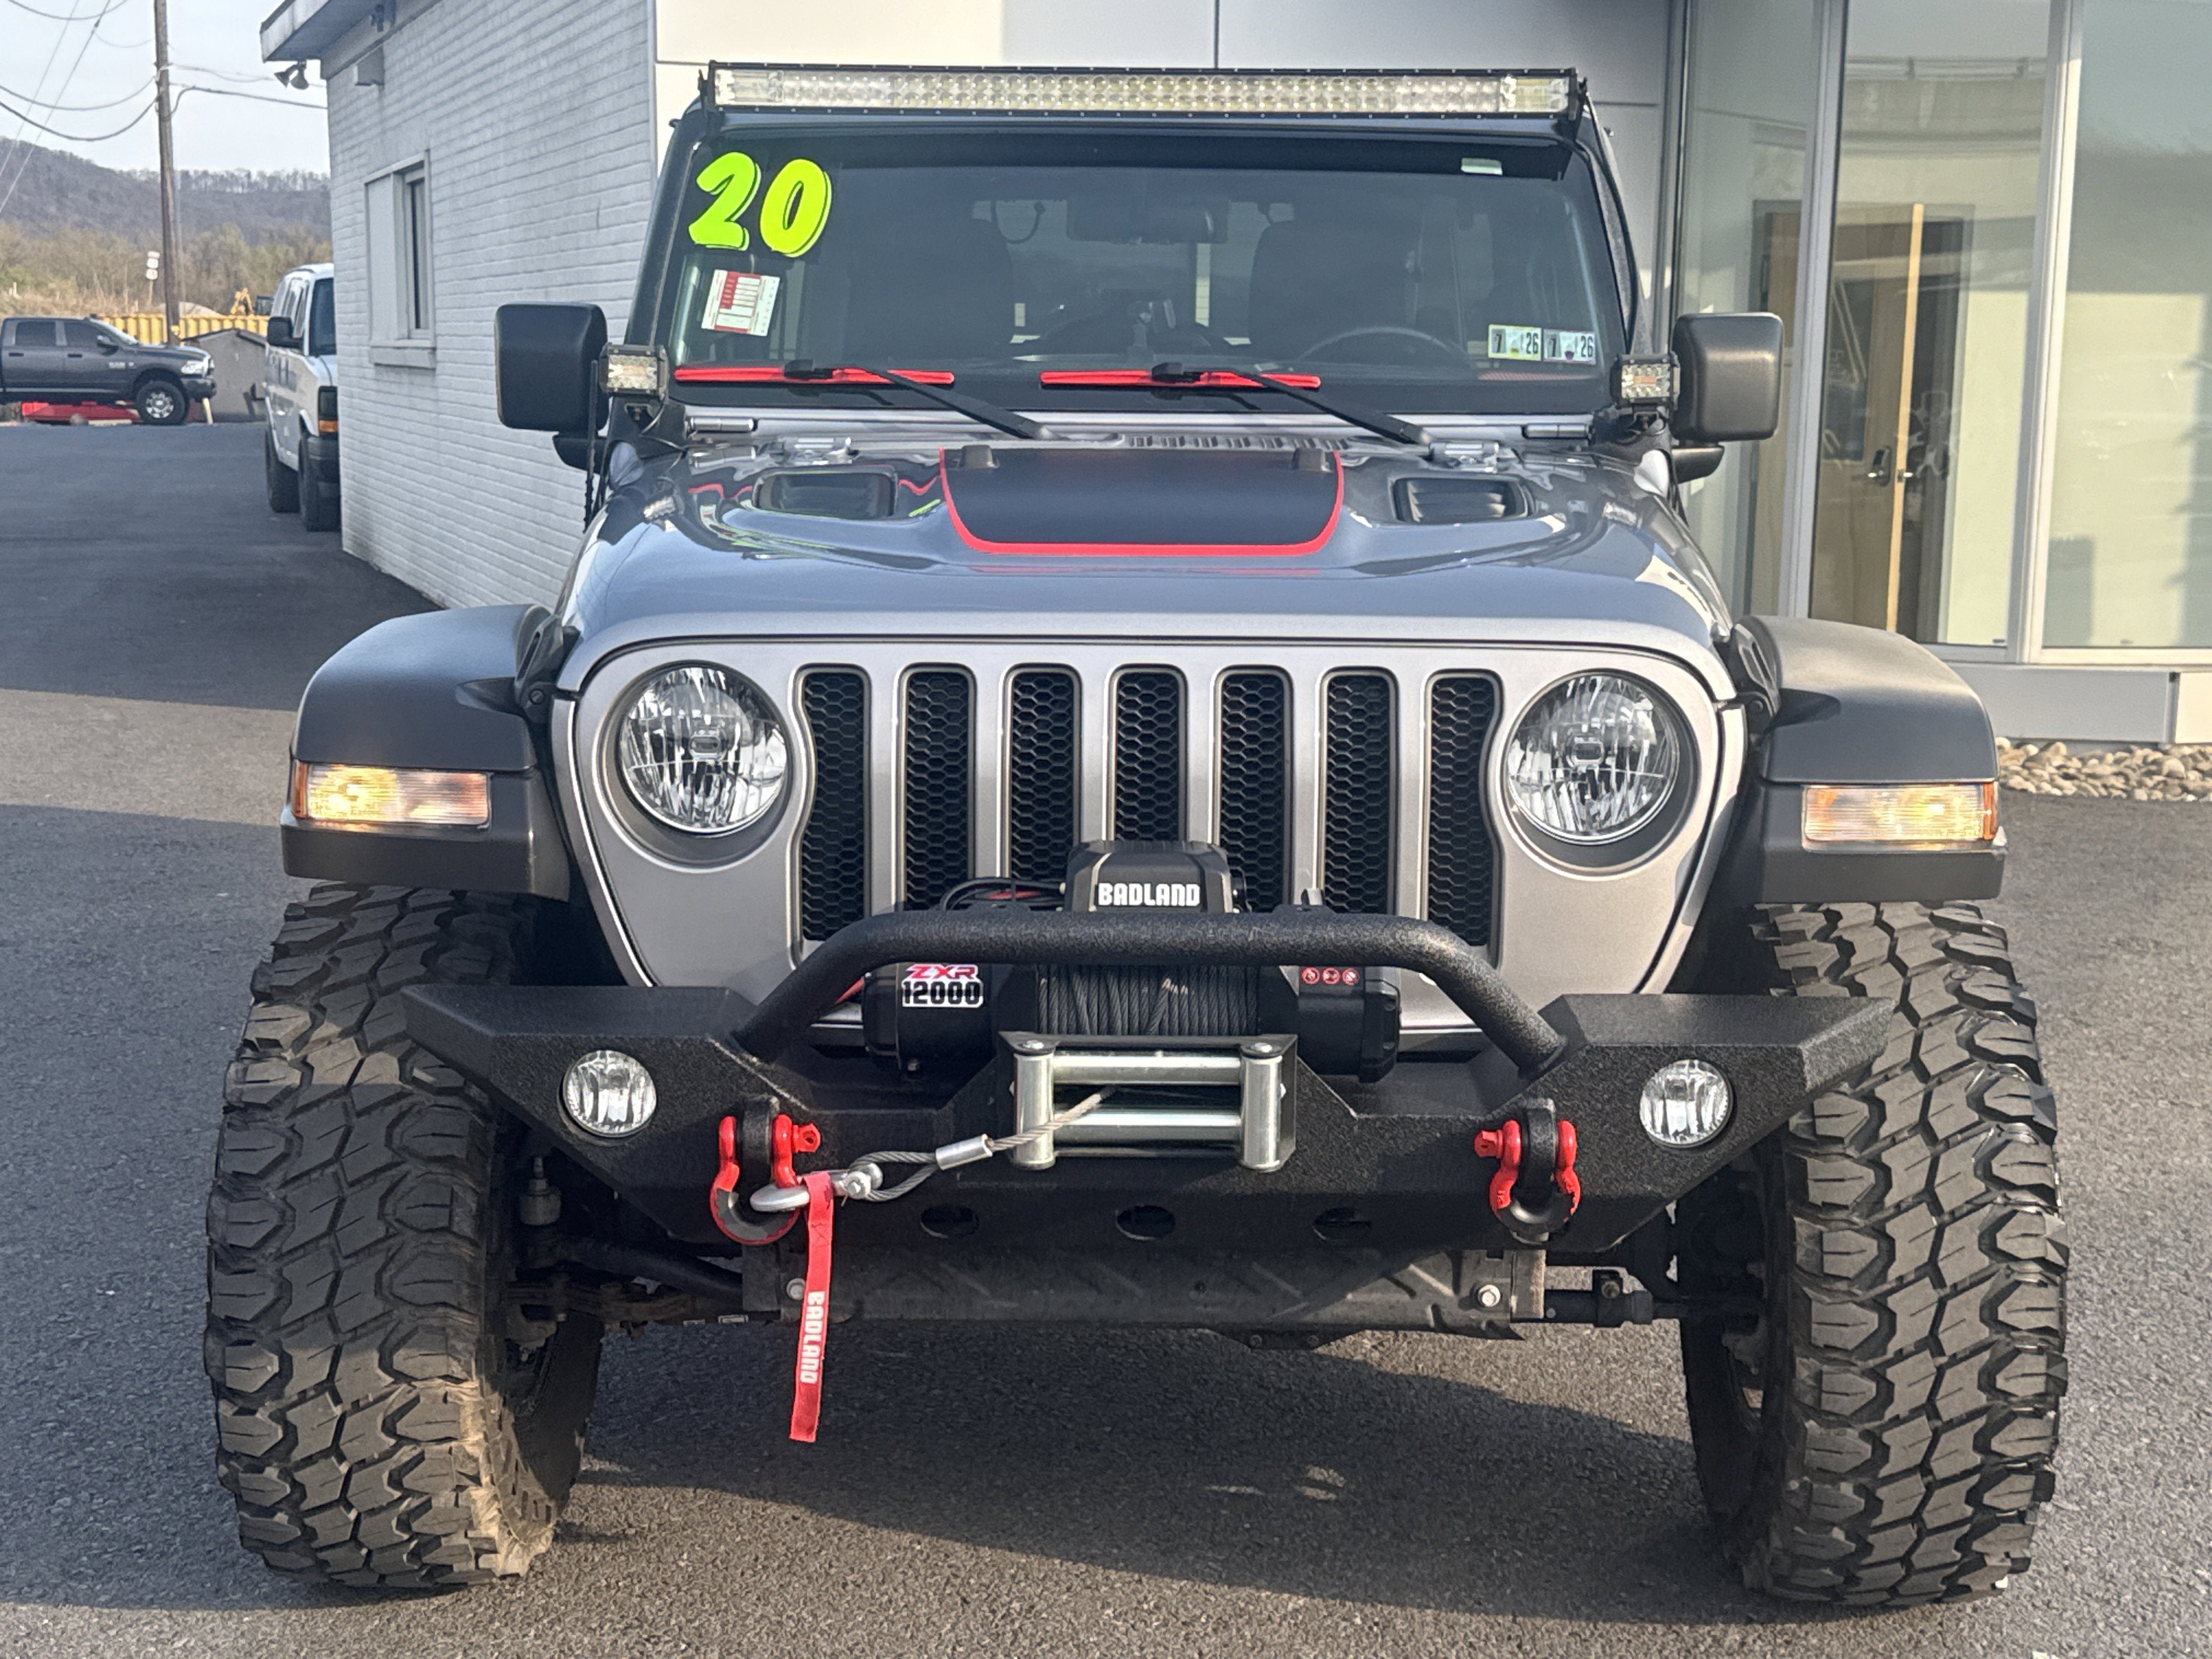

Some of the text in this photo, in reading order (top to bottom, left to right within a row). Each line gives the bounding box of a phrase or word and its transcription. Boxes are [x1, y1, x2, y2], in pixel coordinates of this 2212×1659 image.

[688, 151, 832, 258] 20
[1526, 332, 1539, 354] 26
[1581, 335, 1593, 357] 26
[1098, 883, 1200, 906] BADLAND
[905, 964, 979, 980] ZXR
[902, 980, 984, 1006] 12000
[799, 1290, 825, 1385] BADLAND
